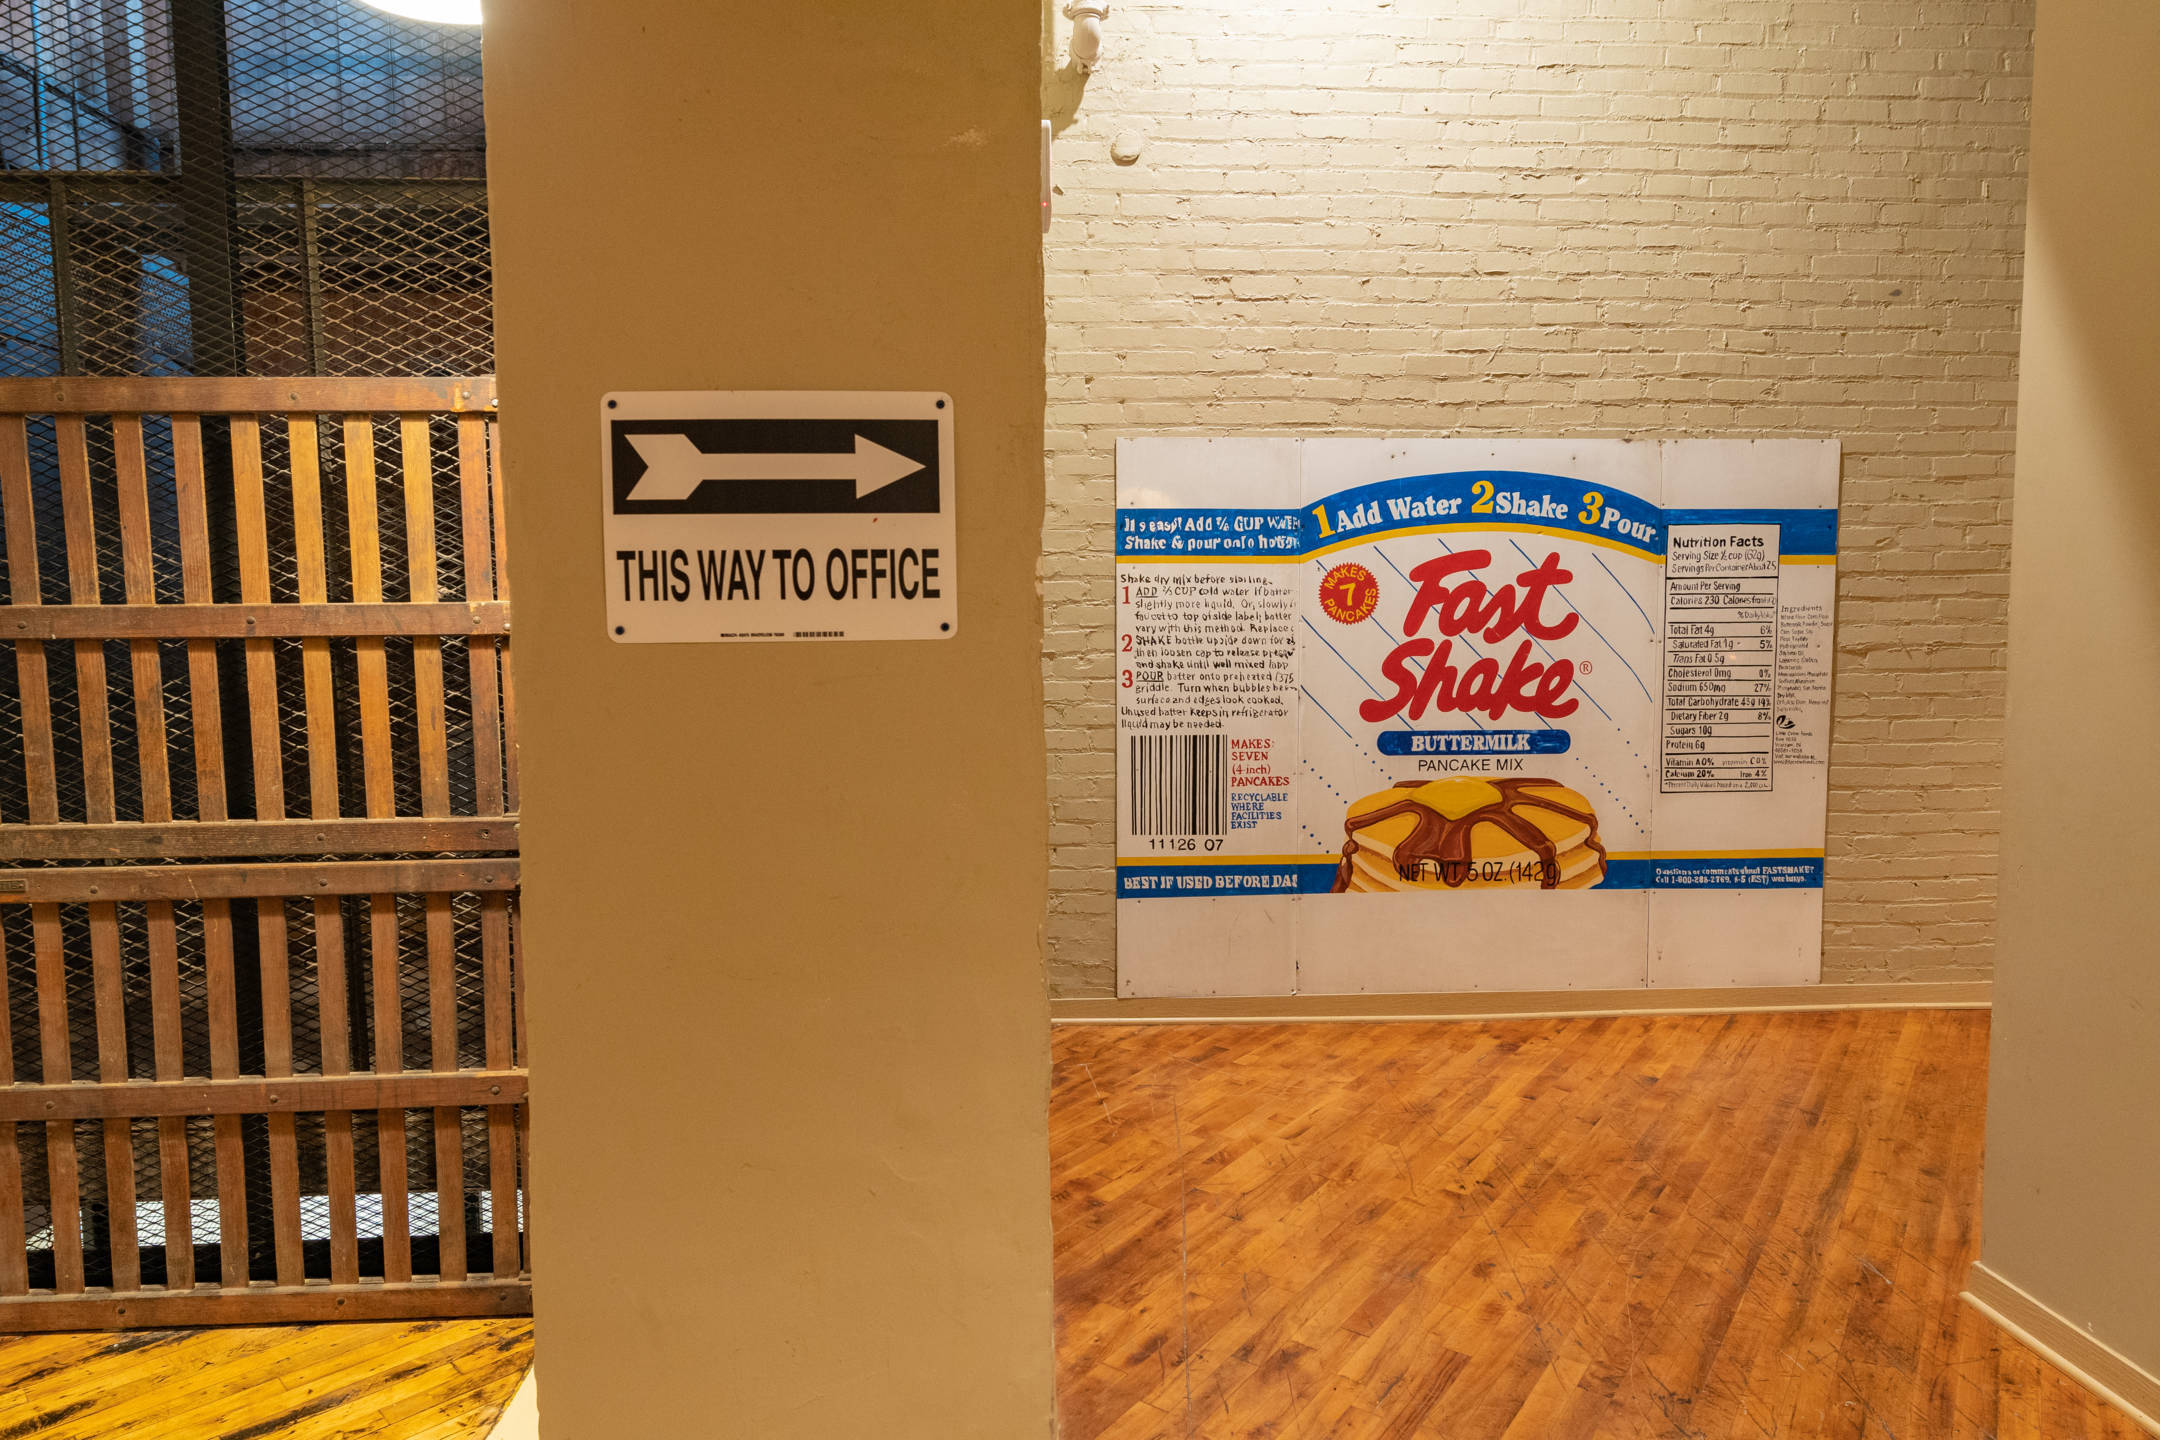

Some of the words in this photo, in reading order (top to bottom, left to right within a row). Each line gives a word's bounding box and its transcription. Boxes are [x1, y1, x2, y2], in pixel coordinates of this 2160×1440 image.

[1312, 504, 1336, 539] 1
[1336, 504, 1383, 533] Add
[1387, 496, 1462, 521] Water
[1471, 480, 1495, 514] 2
[1496, 491, 1569, 520] Shake
[1578, 491, 1604, 525] 3
[1601, 506, 1656, 543] Pour
[1184, 516, 1213, 532] Add
[1124, 535, 1167, 549] Shake
[1171, 535, 1184, 550] &
[1187, 536, 1221, 551] pour
[1673, 537, 1726, 548] Nutrition
[1730, 535, 1765, 547] Facts
[1672, 551, 1701, 562] Serving
[1703, 550, 1720, 561] Size
[1728, 552, 1743, 562] cup
[616, 548, 691, 602] THIS
[697, 548, 766, 601] WAY
[772, 547, 815, 601] TO
[825, 547, 941, 601] OFFICE
[1672, 563, 1705, 575] Servings
[1120, 573, 1151, 584] Shake
[1155, 573, 1170, 585] dry
[1173, 574, 1192, 585] mix
[1194, 573, 1226, 584] before
[1324, 566, 1367, 590] MAKES
[1136, 586, 1158, 598] ADD
[1174, 586, 1197, 596] CUP
[1198, 586, 1219, 596] cold
[1222, 587, 1249, 596] water
[1670, 581, 1699, 591] Amount
[1700, 581, 1712, 591] Per
[1713, 580, 1741, 592] Serving
[1122, 586, 1131, 605] 1
[1339, 582, 1356, 606] 7
[1403, 549, 1580, 644] Fast
[1175, 600, 1201, 609] more
[1258, 599, 1287, 611] slowly
[1324, 588, 1377, 622] PANCAKES
[1670, 596, 1703, 606] Calories
[1704, 595, 1720, 605] 230
[1167, 612, 1179, 621] to
[1183, 611, 1199, 622] top
[1212, 610, 1233, 621] side
[1264, 610, 1292, 621] batter
[1135, 625, 1157, 634] vary
[1183, 623, 1202, 634] this
[1249, 623, 1289, 634] Replace
[1669, 624, 1689, 635] Total
[1690, 624, 1703, 635] Fat
[1704, 624, 1715, 637] 4g
[1760, 624, 1773, 635] 6%
[1121, 633, 1133, 653] 2
[1135, 635, 1172, 647] SHAKE
[1241, 636, 1267, 645] down
[1672, 639, 1709, 650] Saturated
[1710, 639, 1722, 649] Fat
[1723, 637, 1734, 650] 1g
[1759, 639, 1773, 649] 5%
[1195, 649, 1212, 658] cap
[1213, 648, 1224, 657] to
[1226, 647, 1260, 657] release
[1673, 653, 1693, 664] Trans
[1694, 653, 1706, 663] Fat
[1135, 659, 1154, 669] and
[1155, 659, 1185, 670] shake
[1187, 660, 1210, 670] until
[1212, 658, 1232, 669] well
[1234, 659, 1265, 669] mixed
[1121, 669, 1133, 689] 3
[1136, 670, 1164, 682] POUR
[1167, 670, 1196, 681] batter
[1199, 672, 1221, 681] onto
[1223, 670, 1273, 682] preheated
[1668, 668, 1712, 679] Cholesterol
[1714, 668, 1732, 680] 0mg
[1359, 638, 1580, 723] Shake
[1176, 682, 1201, 693] Turn
[1203, 683, 1230, 693] when
[1232, 682, 1271, 694] bubbles
[1668, 682, 1697, 692] Sodium
[1699, 682, 1726, 693] 650mg
[1754, 682, 1772, 693] 27%
[1172, 694, 1191, 704] and
[1193, 694, 1221, 706] edges
[1222, 694, 1245, 704] look
[1667, 697, 1686, 706] Total
[1688, 697, 1739, 707] Carbohydrate
[1121, 705, 1157, 718] Unused
[1189, 705, 1218, 719] keeps
[1219, 705, 1229, 719] in
[1231, 705, 1289, 719] refrigerator
[1670, 711, 1697, 722] Dietary
[1698, 711, 1717, 721] Fiber
[1718, 711, 1729, 722] 2g
[1757, 711, 1772, 721] 8%
[1149, 720, 1171, 731] may
[1172, 719, 1185, 729] be
[1670, 725, 1696, 736] Sugars
[1699, 725, 1712, 736] 10g
[1411, 733, 1531, 752] BUTTERMILK
[1665, 739, 1694, 750] Protein
[1695, 740, 1706, 751] 6g
[1231, 751, 1269, 761] SEVEN
[1665, 758, 1694, 767] Vitamin
[1695, 758, 1700, 766] A
[1701, 757, 1715, 767] 0%
[1749, 757, 1756, 765] C
[1418, 759, 1491, 772] PANCAKE
[1496, 758, 1524, 772] MIX
[1665, 769, 1695, 778] Calcium
[1696, 769, 1715, 778] 20%
[1754, 769, 1767, 778] 4%
[1231, 776, 1290, 787] PANCAKES
[1231, 793, 1288, 802] RECYCLABLE
[1231, 802, 1265, 811] WHERE
[1231, 811, 1282, 820] FACILITIES
[1231, 821, 1258, 829] EXIST
[1400, 862, 1428, 882] NET
[1467, 861, 1479, 882] 5
[1124, 876, 1159, 889] BEST
[1160, 876, 1174, 889] IF
[1176, 875, 1213, 889] USED
[1215, 875, 1270, 889] BEFORE
